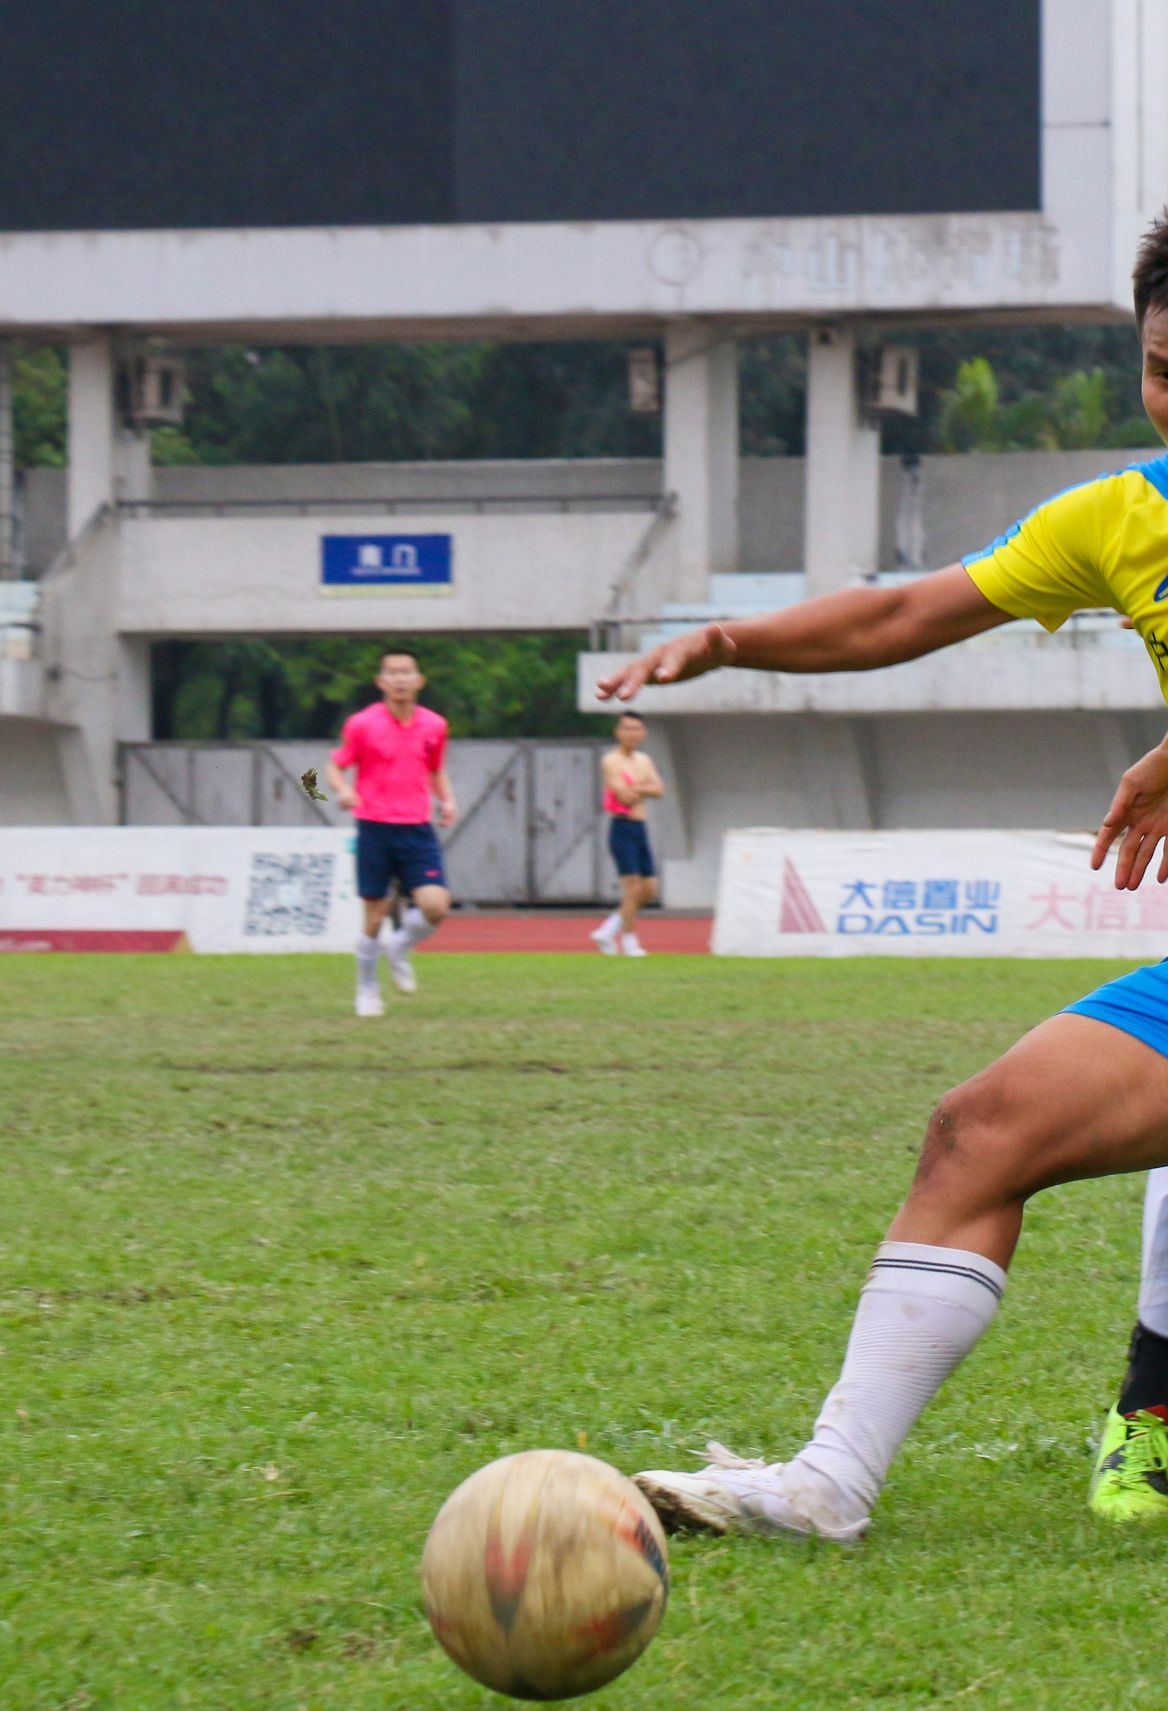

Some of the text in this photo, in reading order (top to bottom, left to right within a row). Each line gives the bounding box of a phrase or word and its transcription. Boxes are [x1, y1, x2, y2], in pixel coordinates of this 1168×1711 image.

[841, 879, 1000, 911] 大信置业
[836, 914, 999, 935] DASIN
